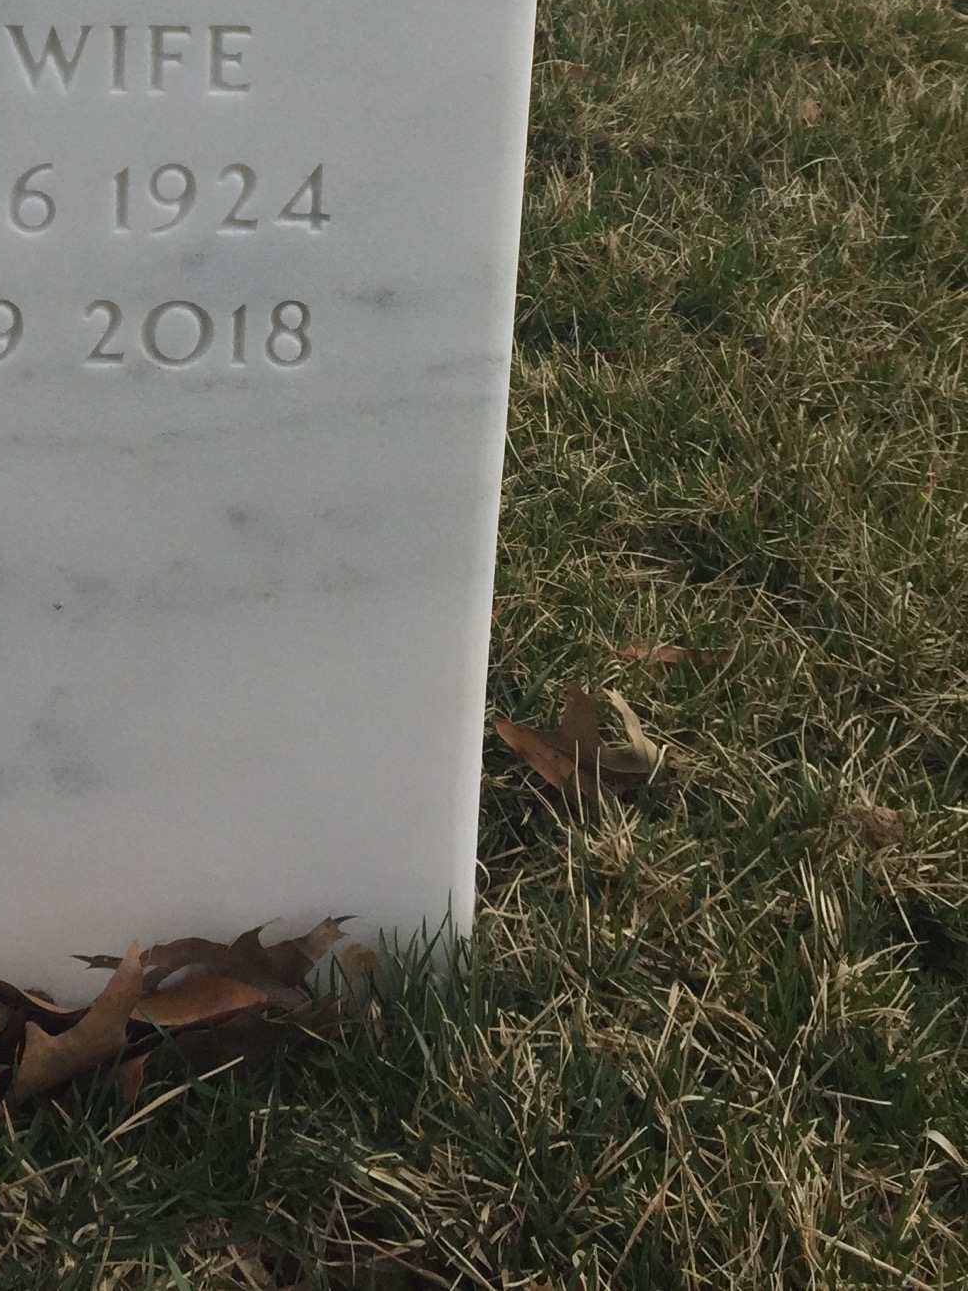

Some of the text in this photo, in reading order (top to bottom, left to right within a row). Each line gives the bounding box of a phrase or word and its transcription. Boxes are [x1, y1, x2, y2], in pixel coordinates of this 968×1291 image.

[4, 23, 253, 95] WIFE
[111, 162, 331, 235] 1924
[84, 299, 313, 370] 2018
